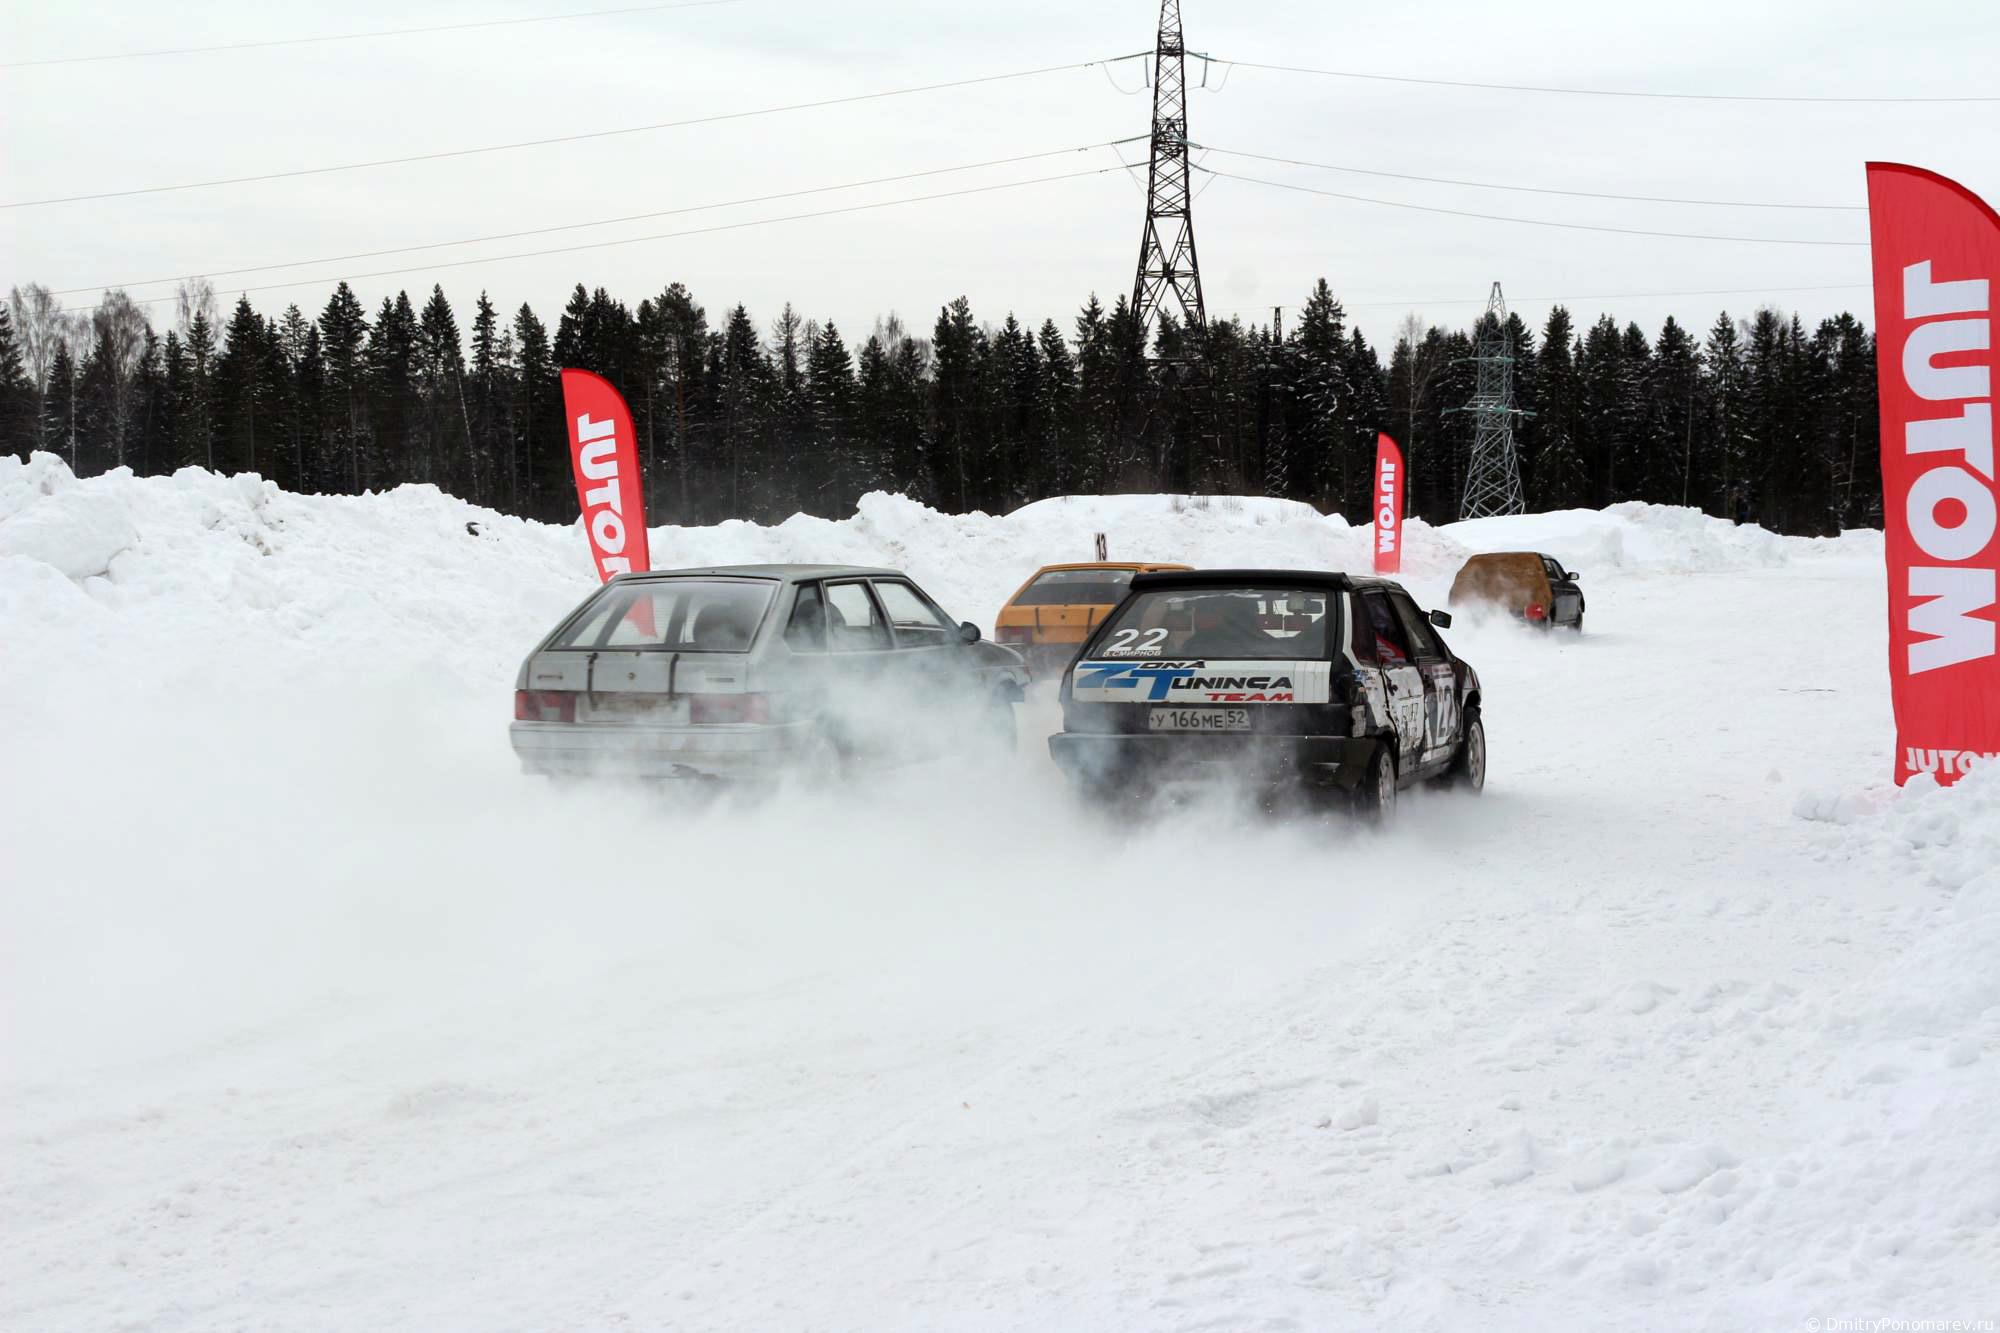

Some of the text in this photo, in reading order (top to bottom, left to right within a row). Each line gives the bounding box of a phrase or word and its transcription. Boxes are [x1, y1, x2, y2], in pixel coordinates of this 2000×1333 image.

[1095, 532, 1107, 561] 13
[1106, 628, 1169, 651] 22
[1129, 669, 1293, 700] TUNINGA
[1204, 692, 1293, 702] TEAM
